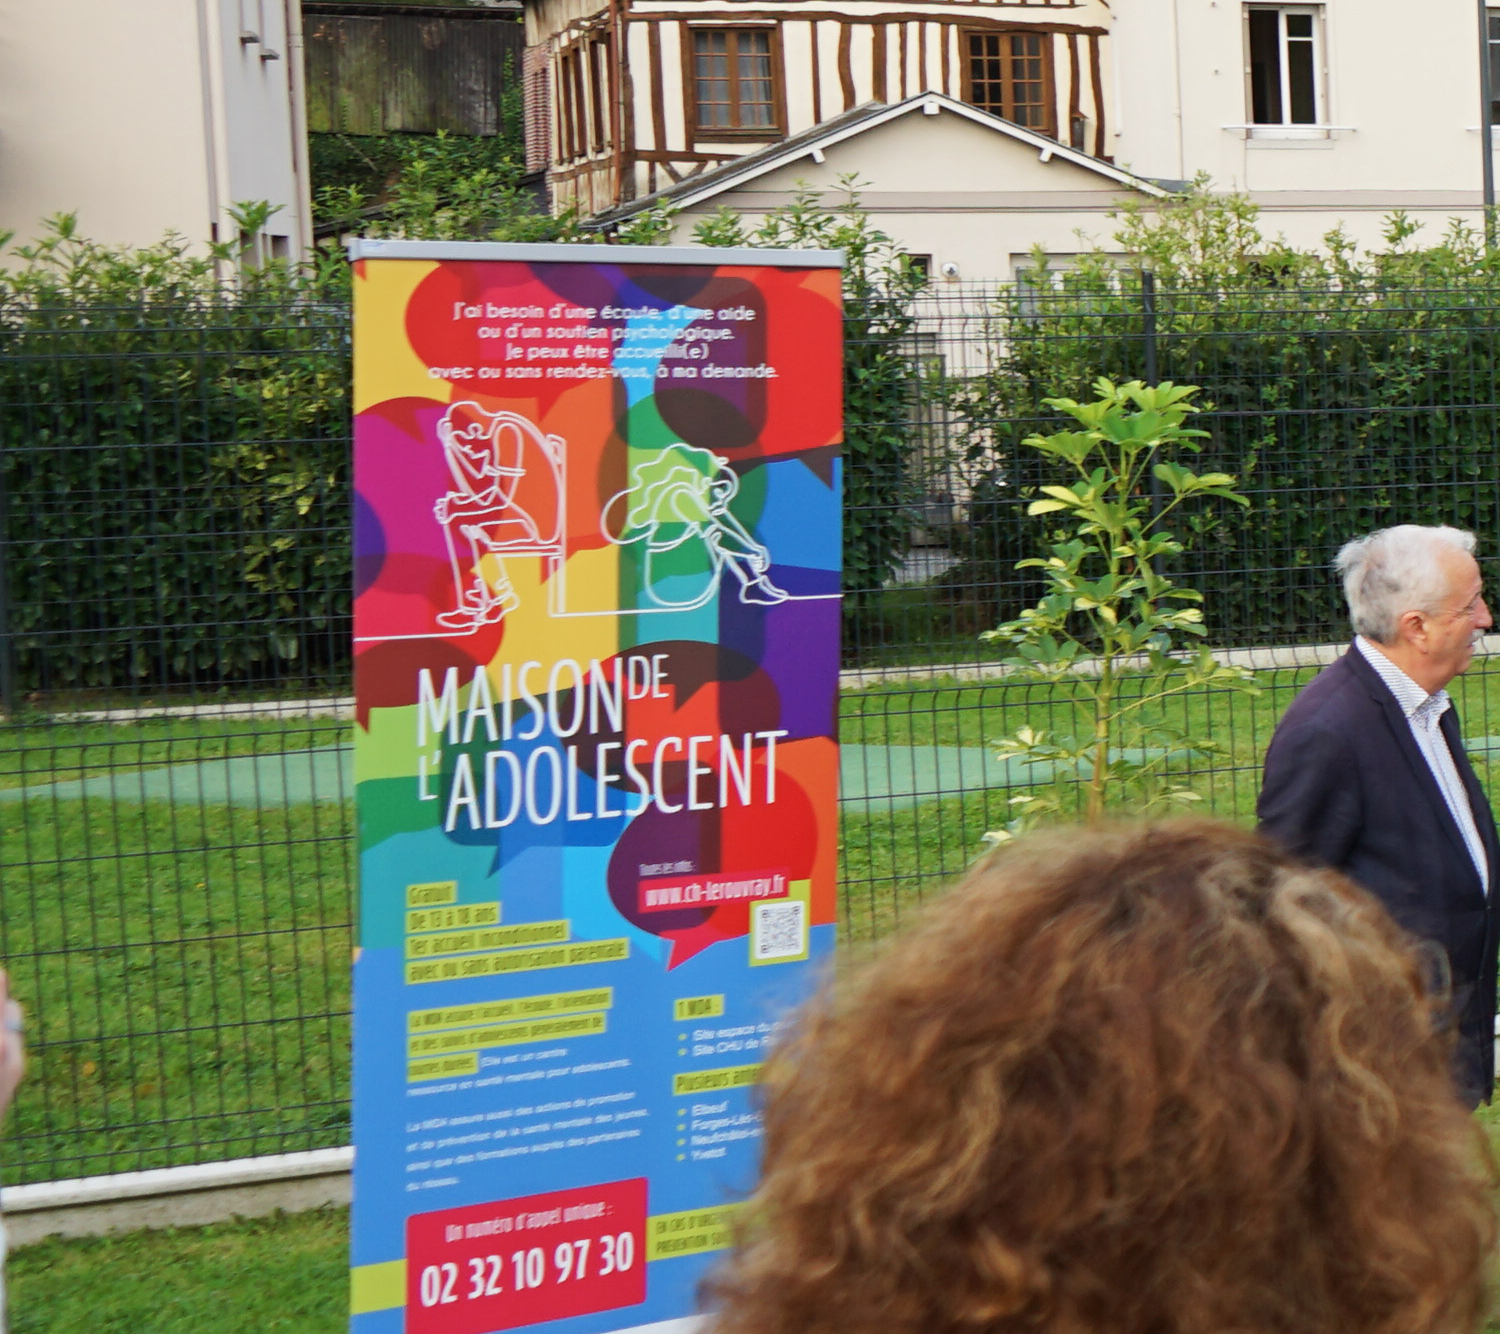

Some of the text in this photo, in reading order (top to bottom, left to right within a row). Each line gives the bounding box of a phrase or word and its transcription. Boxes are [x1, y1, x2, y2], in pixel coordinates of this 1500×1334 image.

[453, 301, 756, 320] J'ai besoin d'une écoute, d'une aide
[478, 323, 735, 342] ou d'un soutien psychologique.
[505, 343, 709, 361] Je peux être accueilli(e)
[428, 363, 779, 380] avec ou sans rendez-vous, à ma demande.
[416, 653, 671, 748] MAISON DE
[418, 729, 789, 833] L'ADOLESCENT
[645, 874, 786, 906] www.ch-lerouvray.fr
[465, 1216, 513, 1239] numéro
[420, 1231, 635, 1308] 02 32 10 97 30
